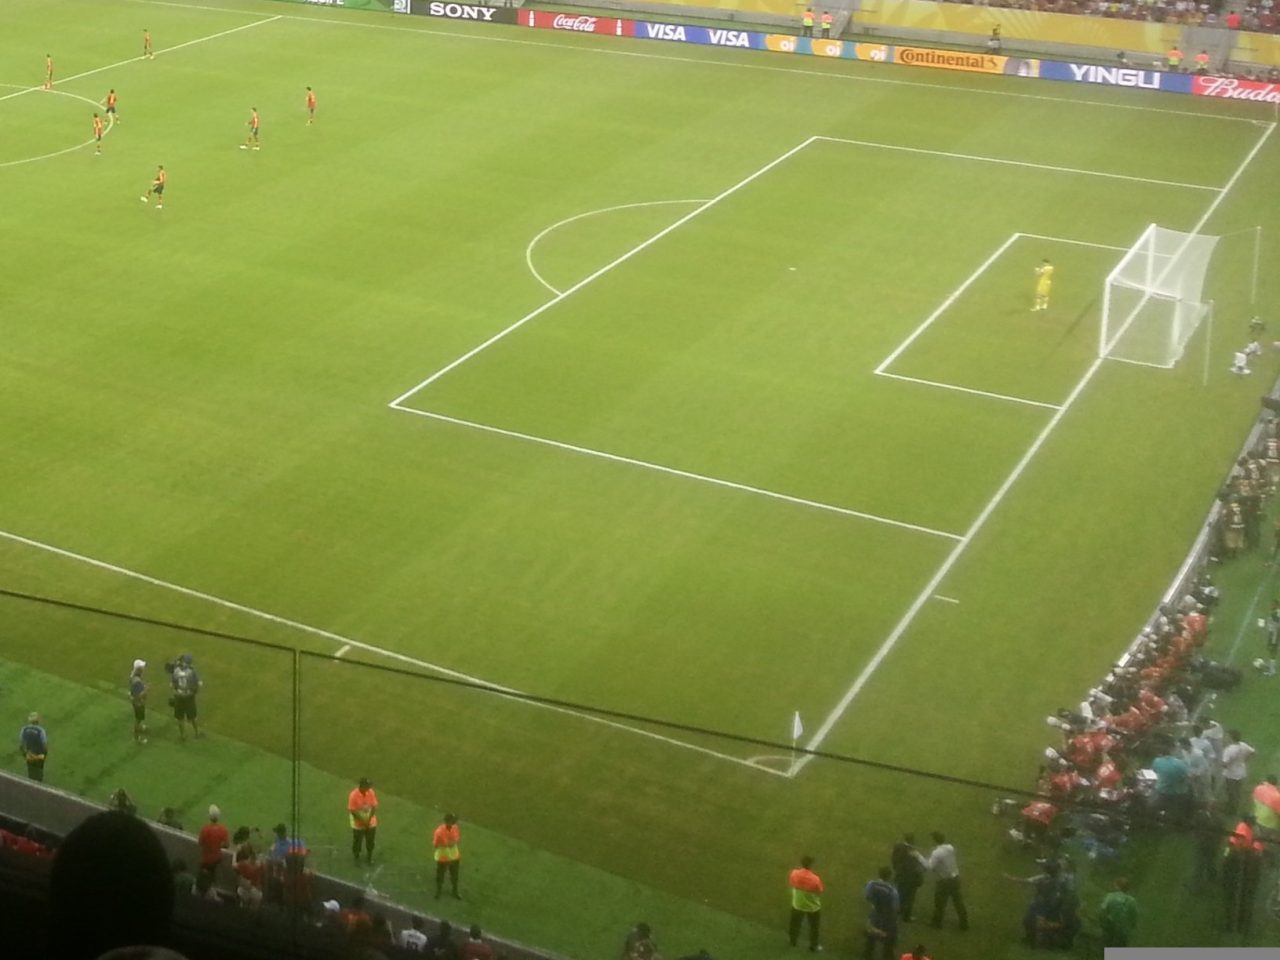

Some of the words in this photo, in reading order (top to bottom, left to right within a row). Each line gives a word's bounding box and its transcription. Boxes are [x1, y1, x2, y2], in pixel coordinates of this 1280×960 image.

[430, 1, 496, 22] SONY
[646, 22, 687, 41] VISA
[709, 29, 750, 48] VISA
[900, 48, 985, 69] Continental
[1070, 63, 1161, 89] YINGLI
